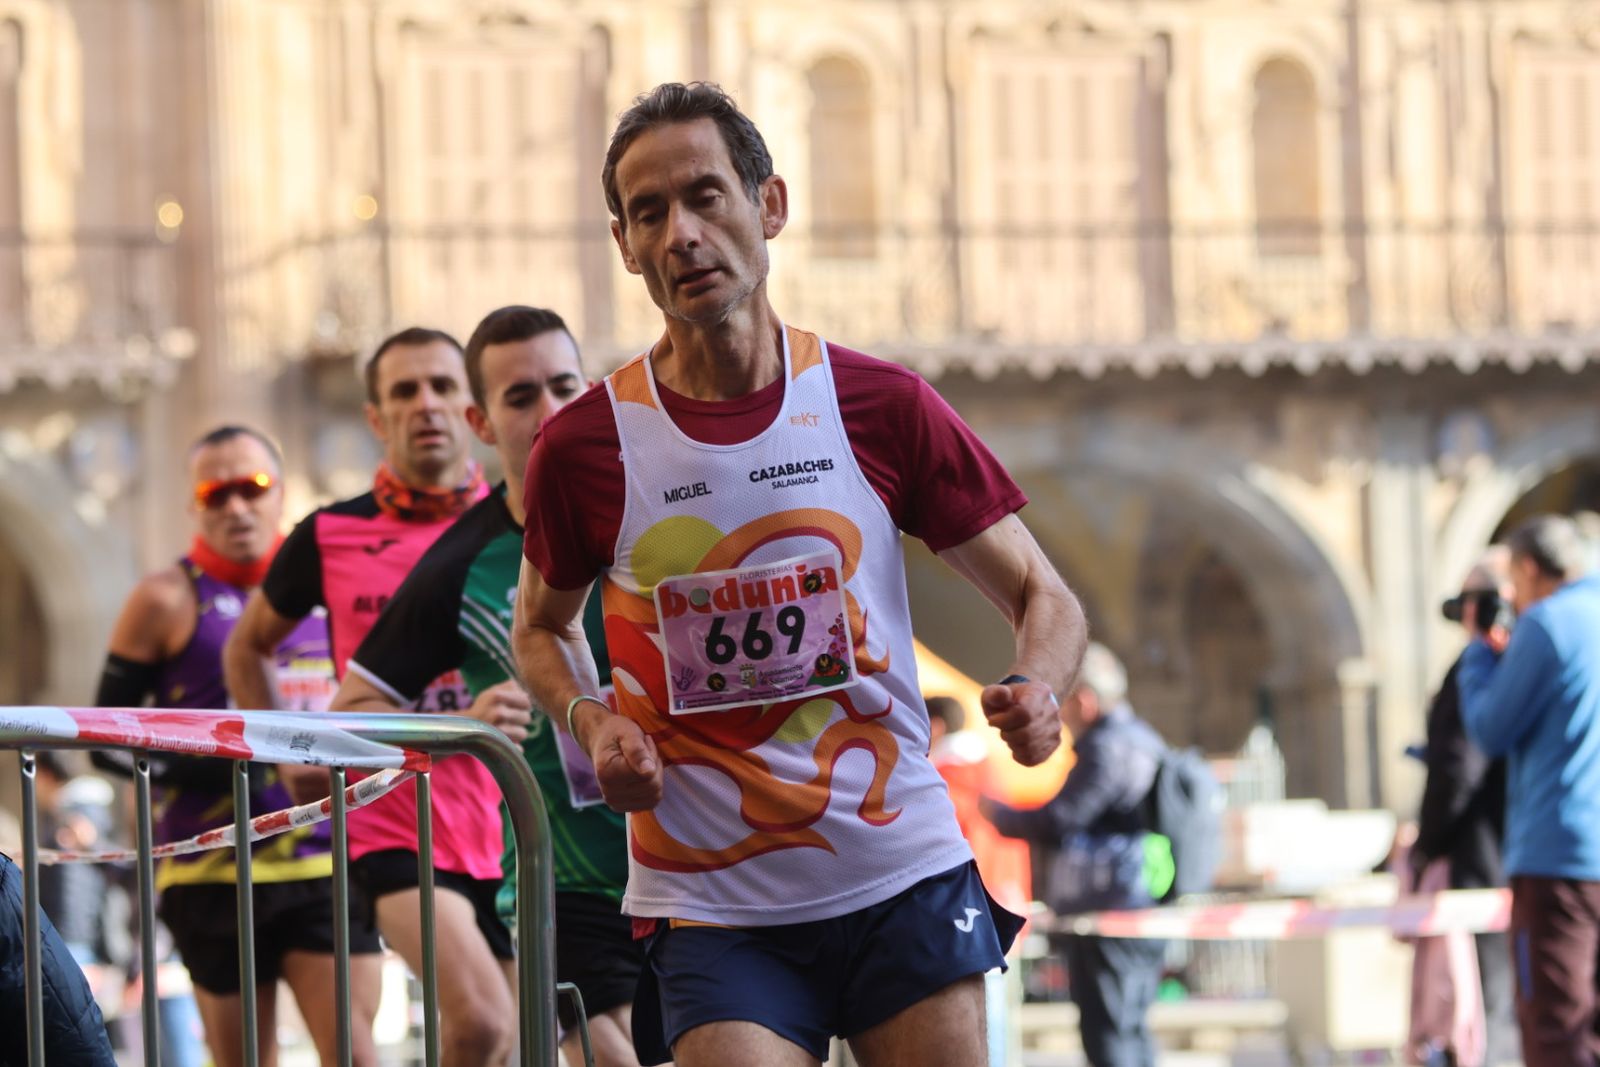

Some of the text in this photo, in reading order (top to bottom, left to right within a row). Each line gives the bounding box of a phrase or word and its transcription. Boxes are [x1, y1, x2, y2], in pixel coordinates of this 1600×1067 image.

[749, 458, 834, 483] CAZABACHES
[664, 482, 712, 504] MIGUEL
[771, 475, 819, 490] SALAMANCA
[739, 564, 793, 581] FLORISTERIAS
[705, 605, 806, 665] 669
[149, 731, 218, 753] Ayuntamiento
